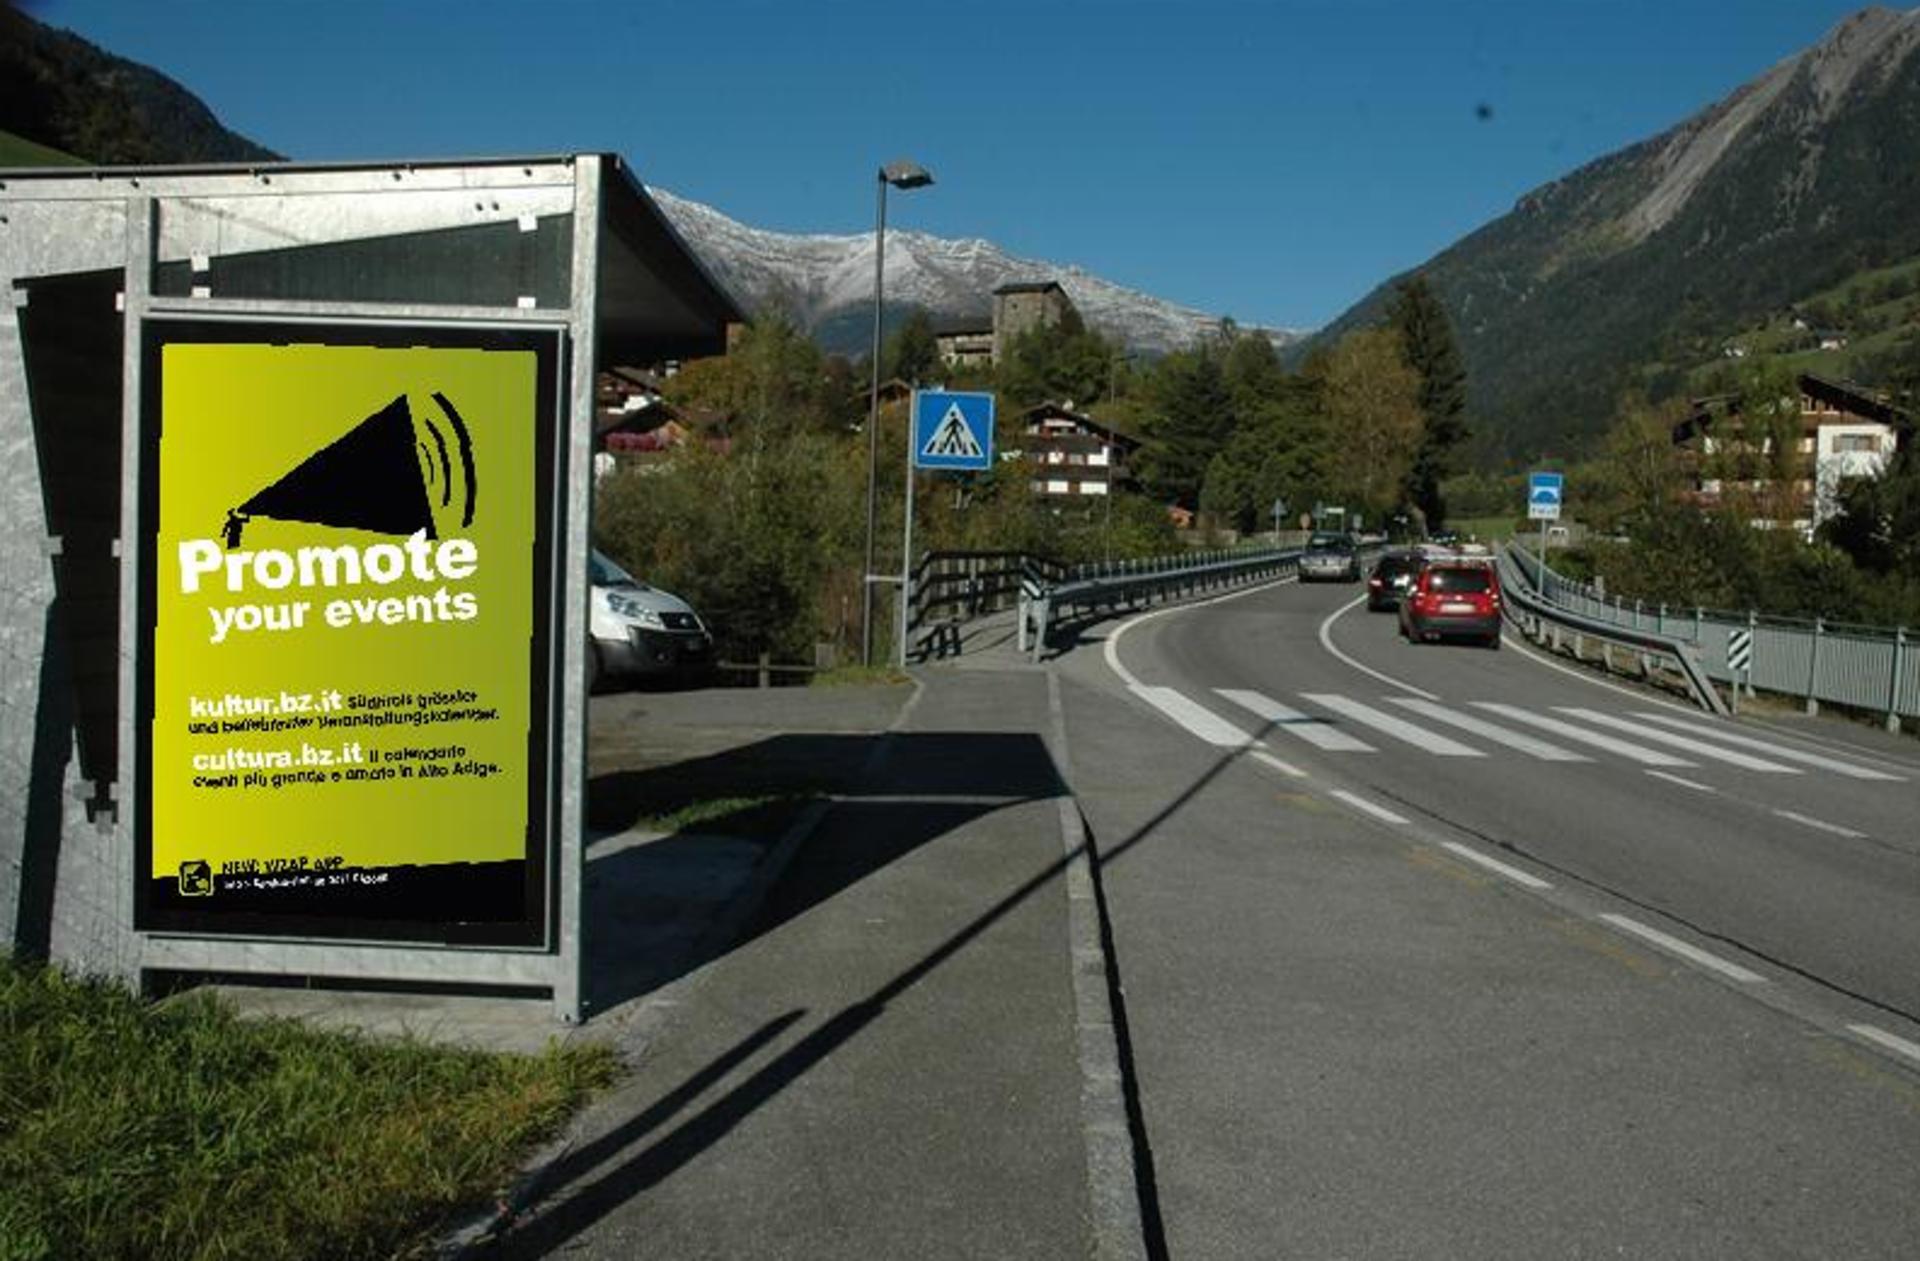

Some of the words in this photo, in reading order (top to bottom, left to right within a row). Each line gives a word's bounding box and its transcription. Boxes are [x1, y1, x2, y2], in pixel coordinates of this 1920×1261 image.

[178, 527, 478, 594] Promote
[208, 600, 311, 644] your
[324, 586, 478, 628] events
[189, 690, 342, 717] kultur.bz.it
[192, 742, 363, 770] cultura.bz.it
